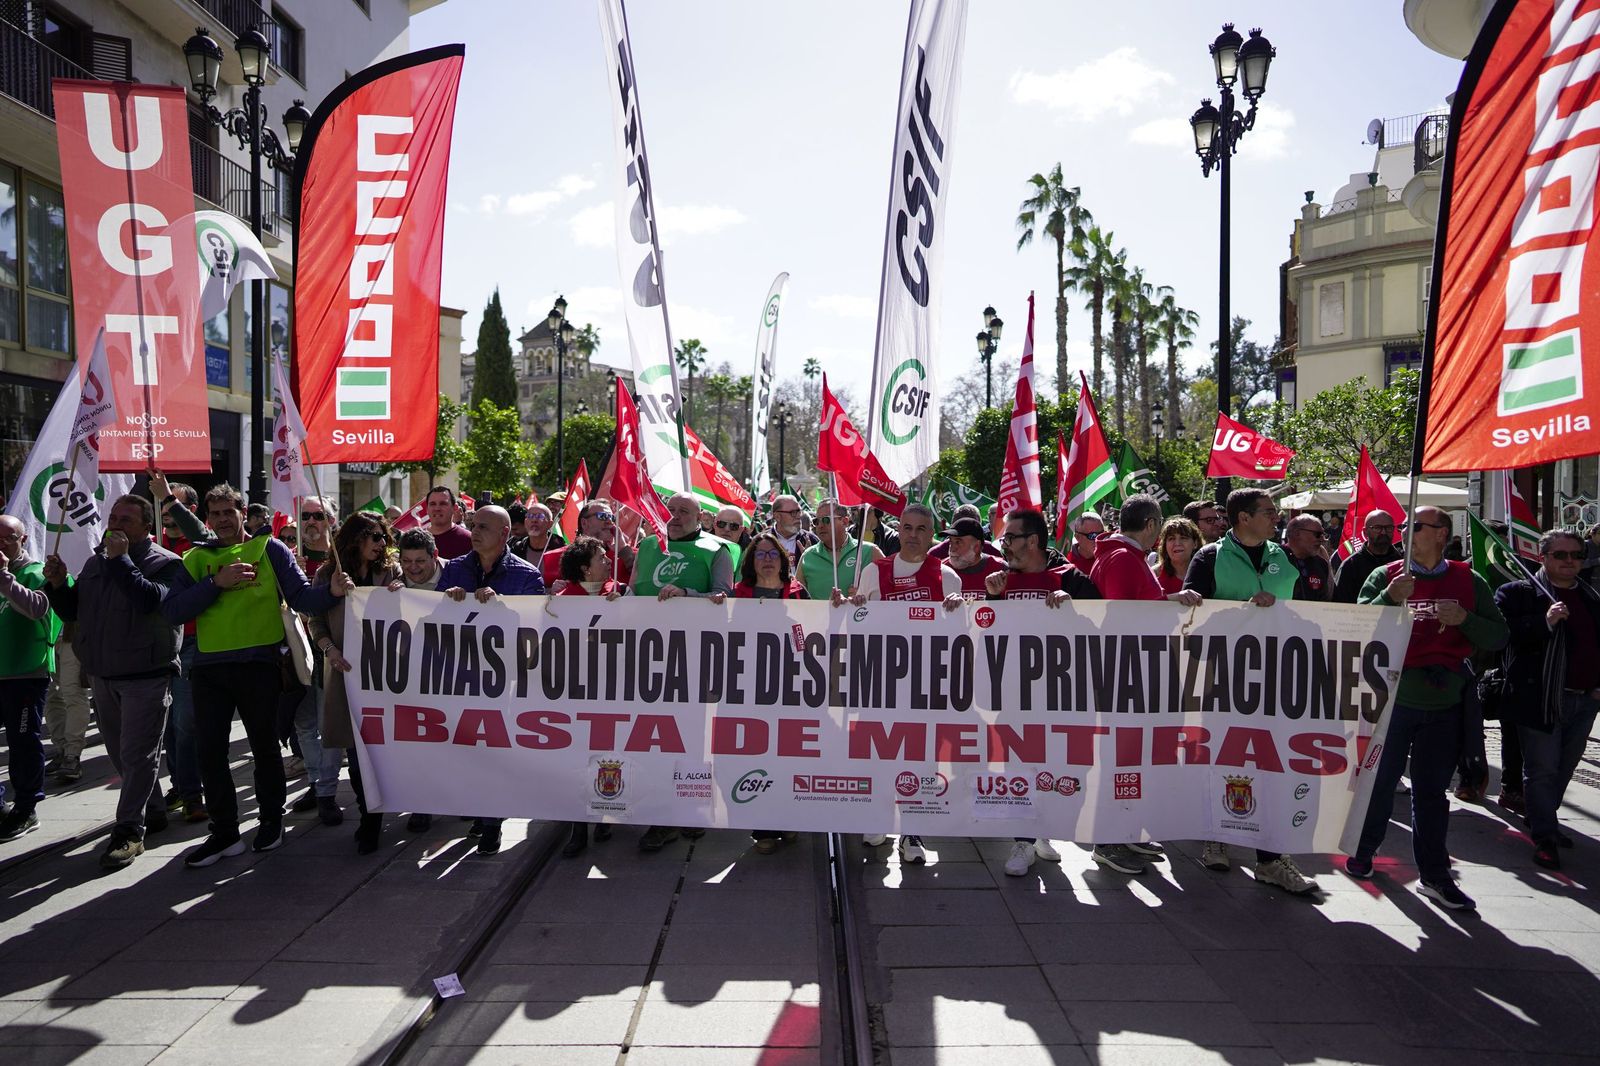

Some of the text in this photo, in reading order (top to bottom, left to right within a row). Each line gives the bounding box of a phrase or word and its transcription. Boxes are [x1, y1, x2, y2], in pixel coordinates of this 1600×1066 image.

[896, 44, 944, 307] CSIF
[83, 91, 178, 386] UGT
[343, 114, 414, 358] CCOO
[892, 384, 930, 418] CSIF
[332, 429, 395, 445] Sevilla
[1492, 413, 1591, 447] Sevilla
[1212, 428, 1266, 454] UGT
[1256, 457, 1285, 465] Sevilla
[713, 472, 750, 505] Sevilla
[861, 469, 901, 496] Sevilla
[50, 478, 102, 529] CSIF
[660, 562, 689, 576] CSIF
[910, 608, 932, 617] USO
[976, 612, 993, 620] UGT
[360, 612, 1390, 724] NO MÁS POLÍTICA DE DESEMPLEO Y PRIVATIZACIONES
[360, 705, 1372, 777] ¡BASTA DE MENTIRAS!
[673, 771, 682, 780] EL
[898, 775, 916, 785] UGT
[921, 777, 936, 785] FSP
[1059, 778, 1075, 787] UGT
[1116, 774, 1138, 783] USO
[977, 776, 1029, 796] USO
[1116, 786, 1138, 796] USO
[850, 795, 872, 803] Sevilla
